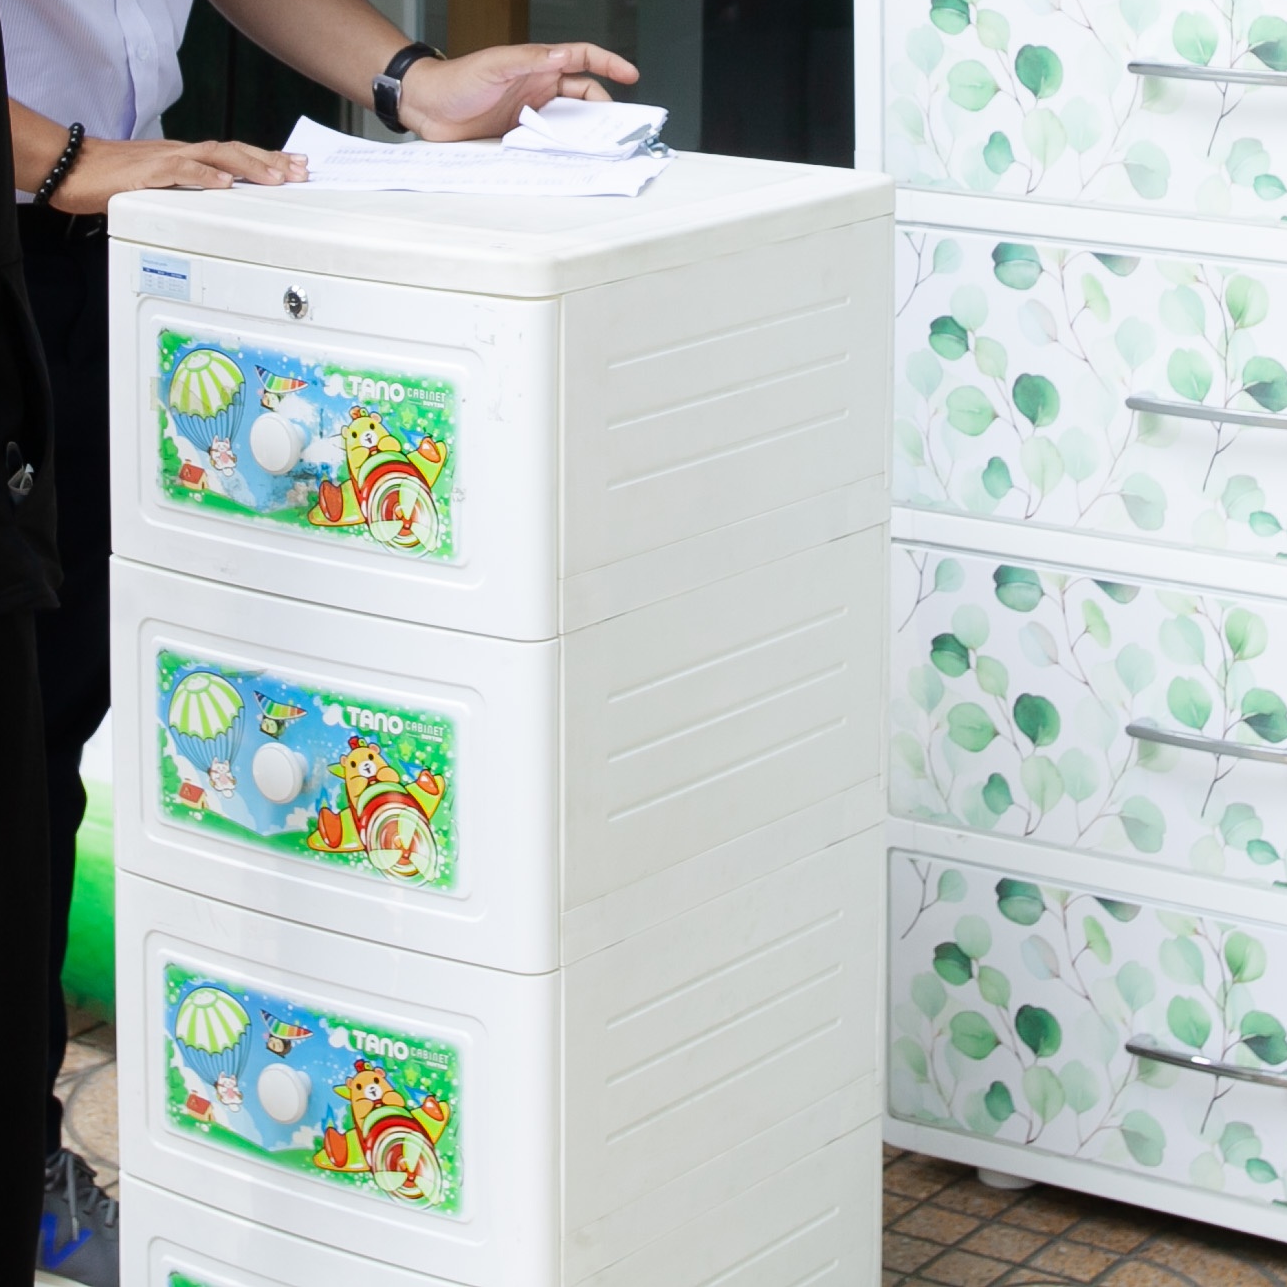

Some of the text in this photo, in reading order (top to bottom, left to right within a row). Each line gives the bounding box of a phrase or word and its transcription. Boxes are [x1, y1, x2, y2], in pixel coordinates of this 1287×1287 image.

[347, 374, 447, 403] TANO CABINET
[346, 705, 445, 737] TANO CABINET
[351, 1029, 450, 1065] TANO CABINET
